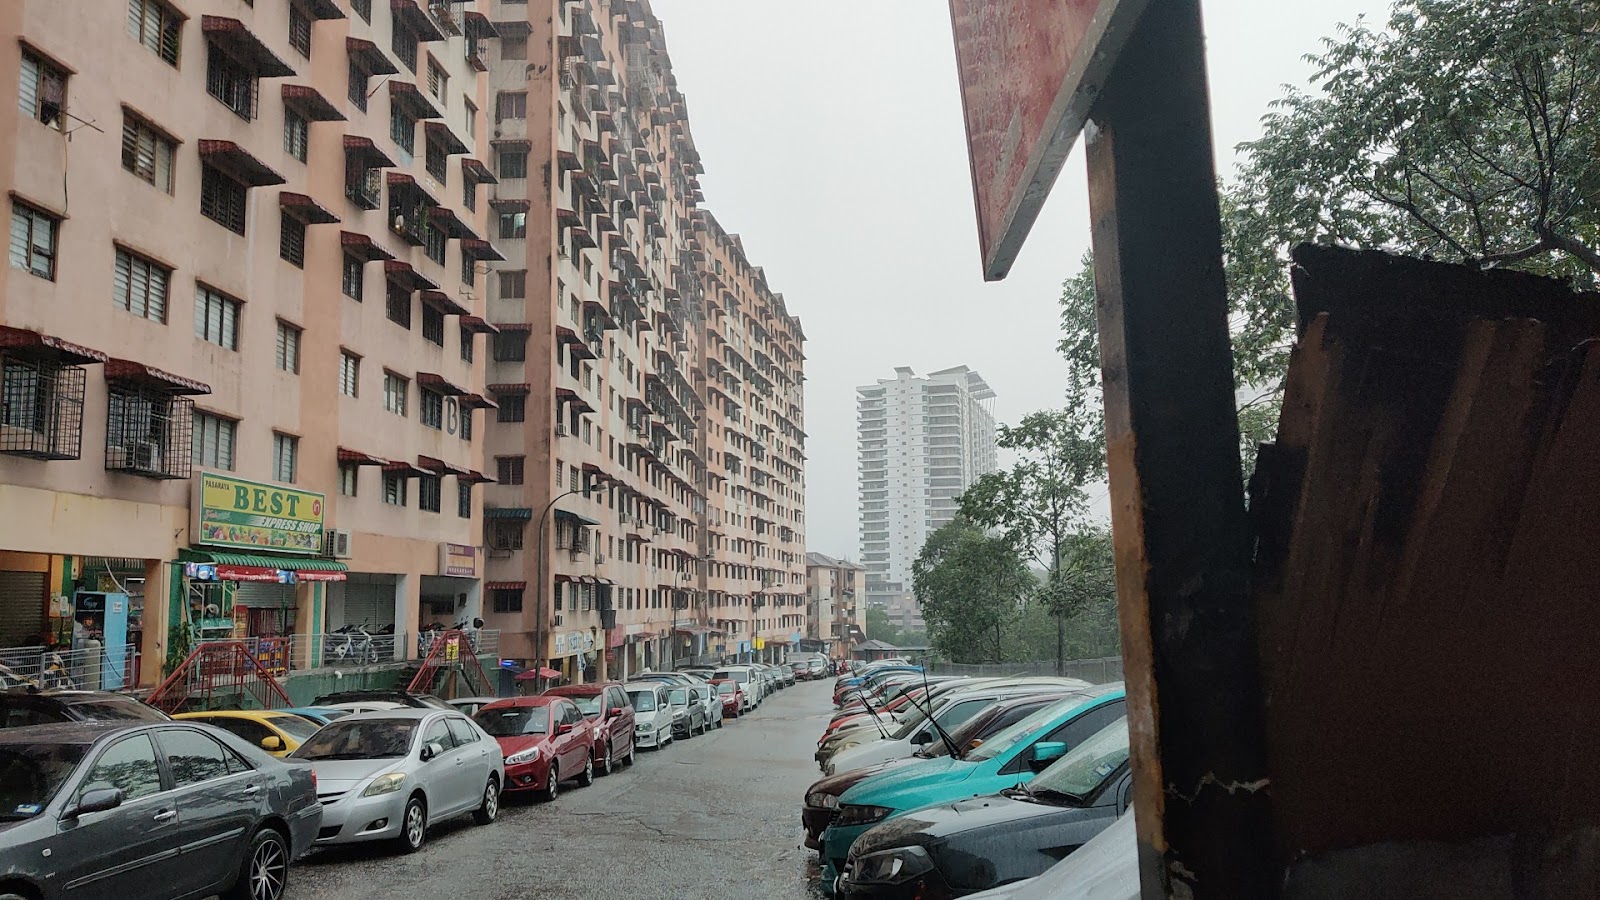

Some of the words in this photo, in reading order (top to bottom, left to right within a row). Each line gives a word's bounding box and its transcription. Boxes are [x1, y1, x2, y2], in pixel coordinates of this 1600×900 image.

[445, 397, 457, 435] B
[206, 480, 230, 490] PASARAYA
[234, 485, 300, 516] BEST
[262, 517, 297, 531] EXPRESS
[297, 522, 320, 533] SHOP
